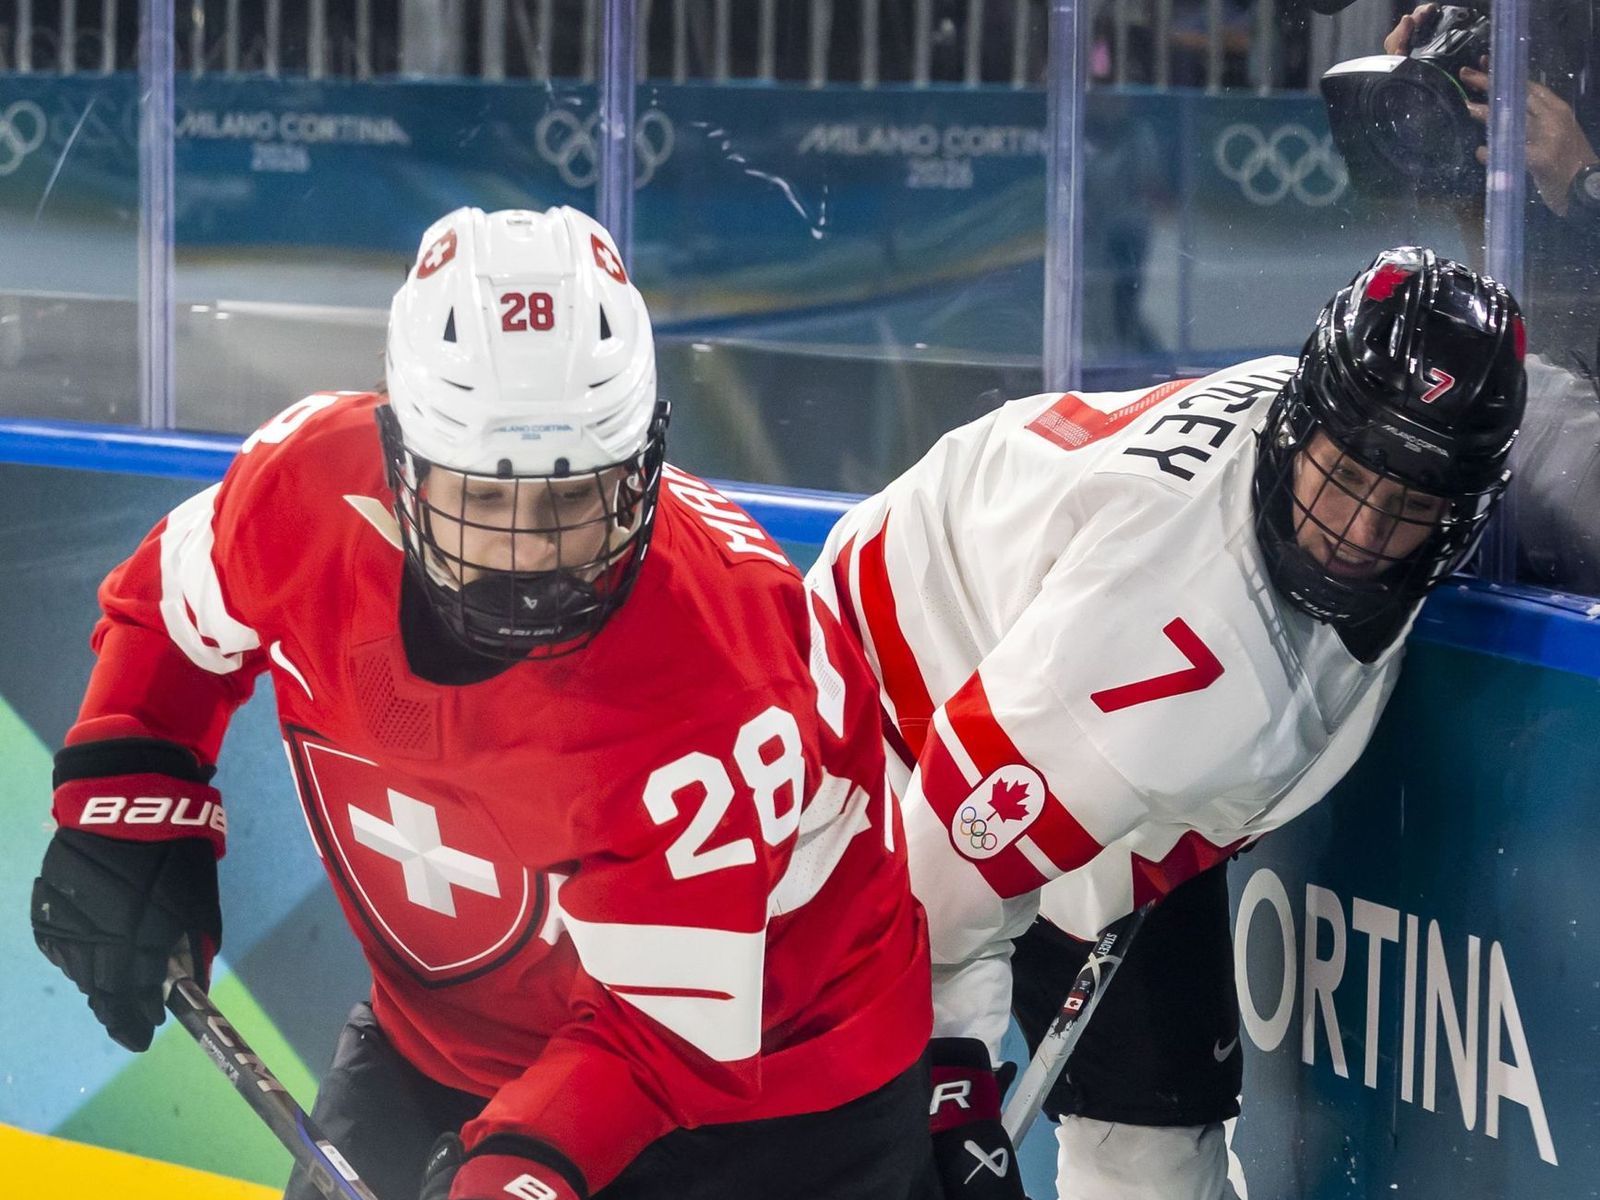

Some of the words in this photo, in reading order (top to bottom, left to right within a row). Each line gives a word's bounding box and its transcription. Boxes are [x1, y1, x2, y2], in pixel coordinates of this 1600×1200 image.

[944, 125, 1048, 156] CORTIN
[500, 292, 555, 332] 28
[1420, 367, 1455, 404] 7
[1089, 616, 1226, 714] 7
[641, 704, 806, 881] 28
[1234, 867, 1559, 1167] ORTINA
